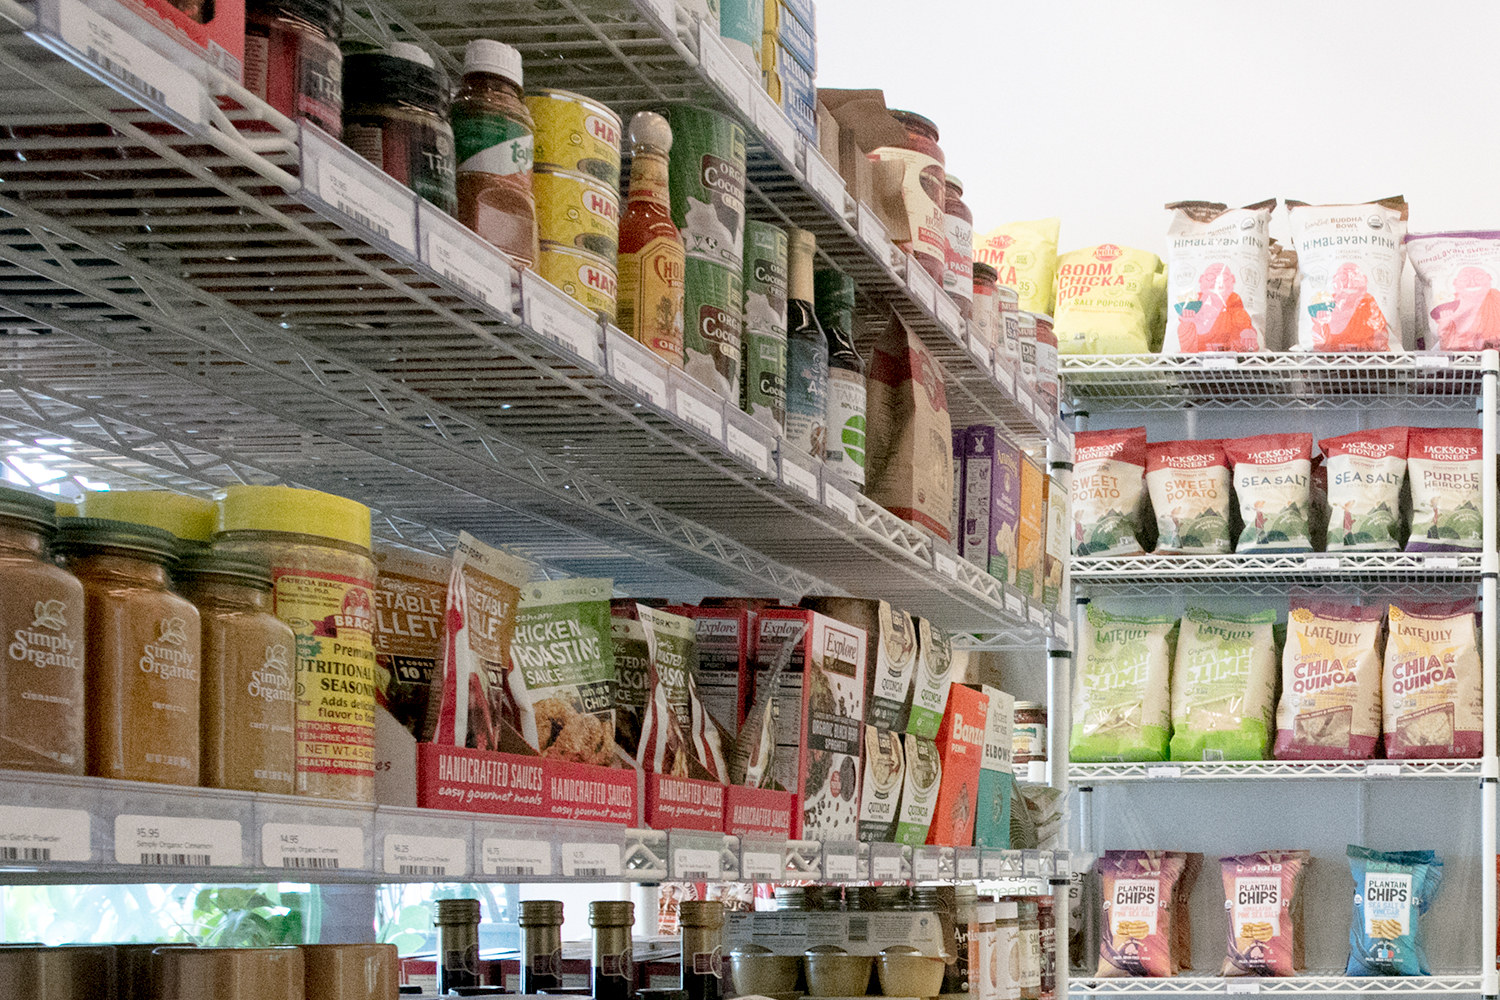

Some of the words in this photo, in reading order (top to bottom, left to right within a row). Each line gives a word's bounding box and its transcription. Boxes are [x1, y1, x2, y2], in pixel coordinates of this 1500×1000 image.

[1173, 236, 1240, 249] HIMALAYAN
[1302, 235, 1369, 251] HIMALAYAN
[1371, 237, 1396, 250] PINK
[1060, 263, 1113, 277] BOOM
[1058, 275, 1125, 289] CHICKA
[1058, 285, 1092, 306] POP
[1255, 455, 1294, 464] HONEST
[1241, 476, 1273, 488] SEA
[1275, 473, 1308, 488] SALT
[1335, 471, 1363, 485] SEA
[1365, 471, 1399, 485] SALT
[1423, 470, 1479, 483] PURPLE
[1165, 478, 1216, 492] SWEET
[1424, 480, 1479, 491] HEIRLOOM
[1166, 488, 1217, 504] POTATO
[697, 620, 736, 635] Explore
[14, 628, 77, 655] Simply
[827, 632, 857, 660] Explore
[8, 641, 81, 671] Organic
[144, 643, 195, 669] Simply
[519, 638, 601, 668] ROASTING
[139, 655, 197, 683] Organic
[401, 667, 418, 679] 10
[1293, 658, 1344, 677] CHIA
[1392, 657, 1441, 678] CHIA
[527, 669, 564, 686] SAUCE
[1293, 672, 1357, 695] QUINOA
[1392, 668, 1456, 694] QUINOA
[881, 677, 904, 694] QUINOA
[322, 697, 348, 708] Adds
[319, 707, 353, 719] flavor
[355, 712, 364, 722] to
[305, 744, 330, 755] NET
[333, 746, 350, 757] WT
[985, 743, 1010, 762] ELBOWS
[438, 754, 509, 789] HANDCRAFTED
[511, 765, 543, 792] SAUCES
[438, 787, 463, 798] easy
[466, 788, 514, 804] gourmet
[515, 792, 542, 806] meals
[551, 776, 600, 804] HANDCRAFTED
[602, 784, 632, 808] SAUCES
[867, 800, 891, 815] QUINOA
[1118, 884, 1155, 893] PLANTAIN
[1240, 884, 1278, 894] PLANTAIN
[1369, 880, 1407, 889] PLANTAIN
[1116, 890, 1155, 905] CHIPS
[1238, 891, 1278, 905] CHIPS
